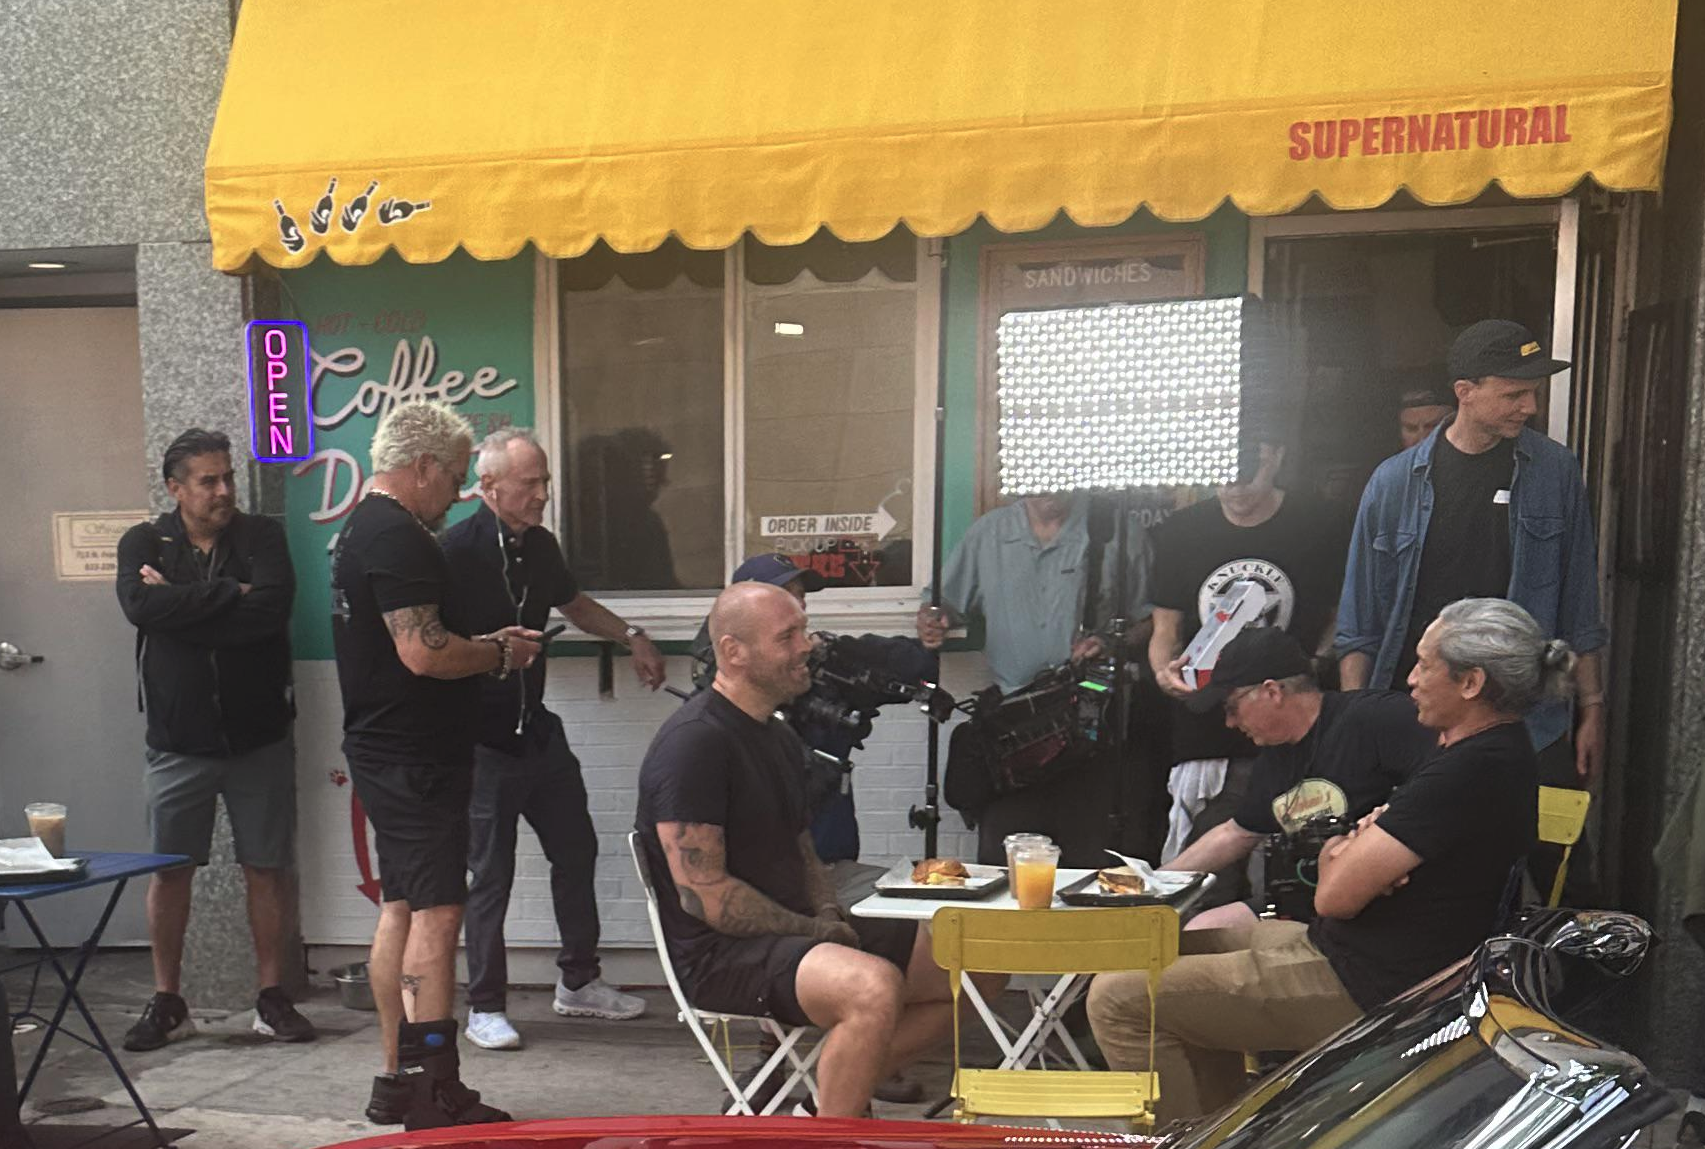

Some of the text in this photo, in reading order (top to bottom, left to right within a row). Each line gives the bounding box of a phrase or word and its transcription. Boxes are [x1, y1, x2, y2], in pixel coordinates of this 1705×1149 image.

[1288, 104, 1571, 161] SUPERNATURAL
[1024, 262, 1152, 288] SANDWICHES
[264, 329, 293, 455] OPEN
[308, 335, 517, 427] Coffee
[767, 516, 873, 533] ORDER INSIDE
